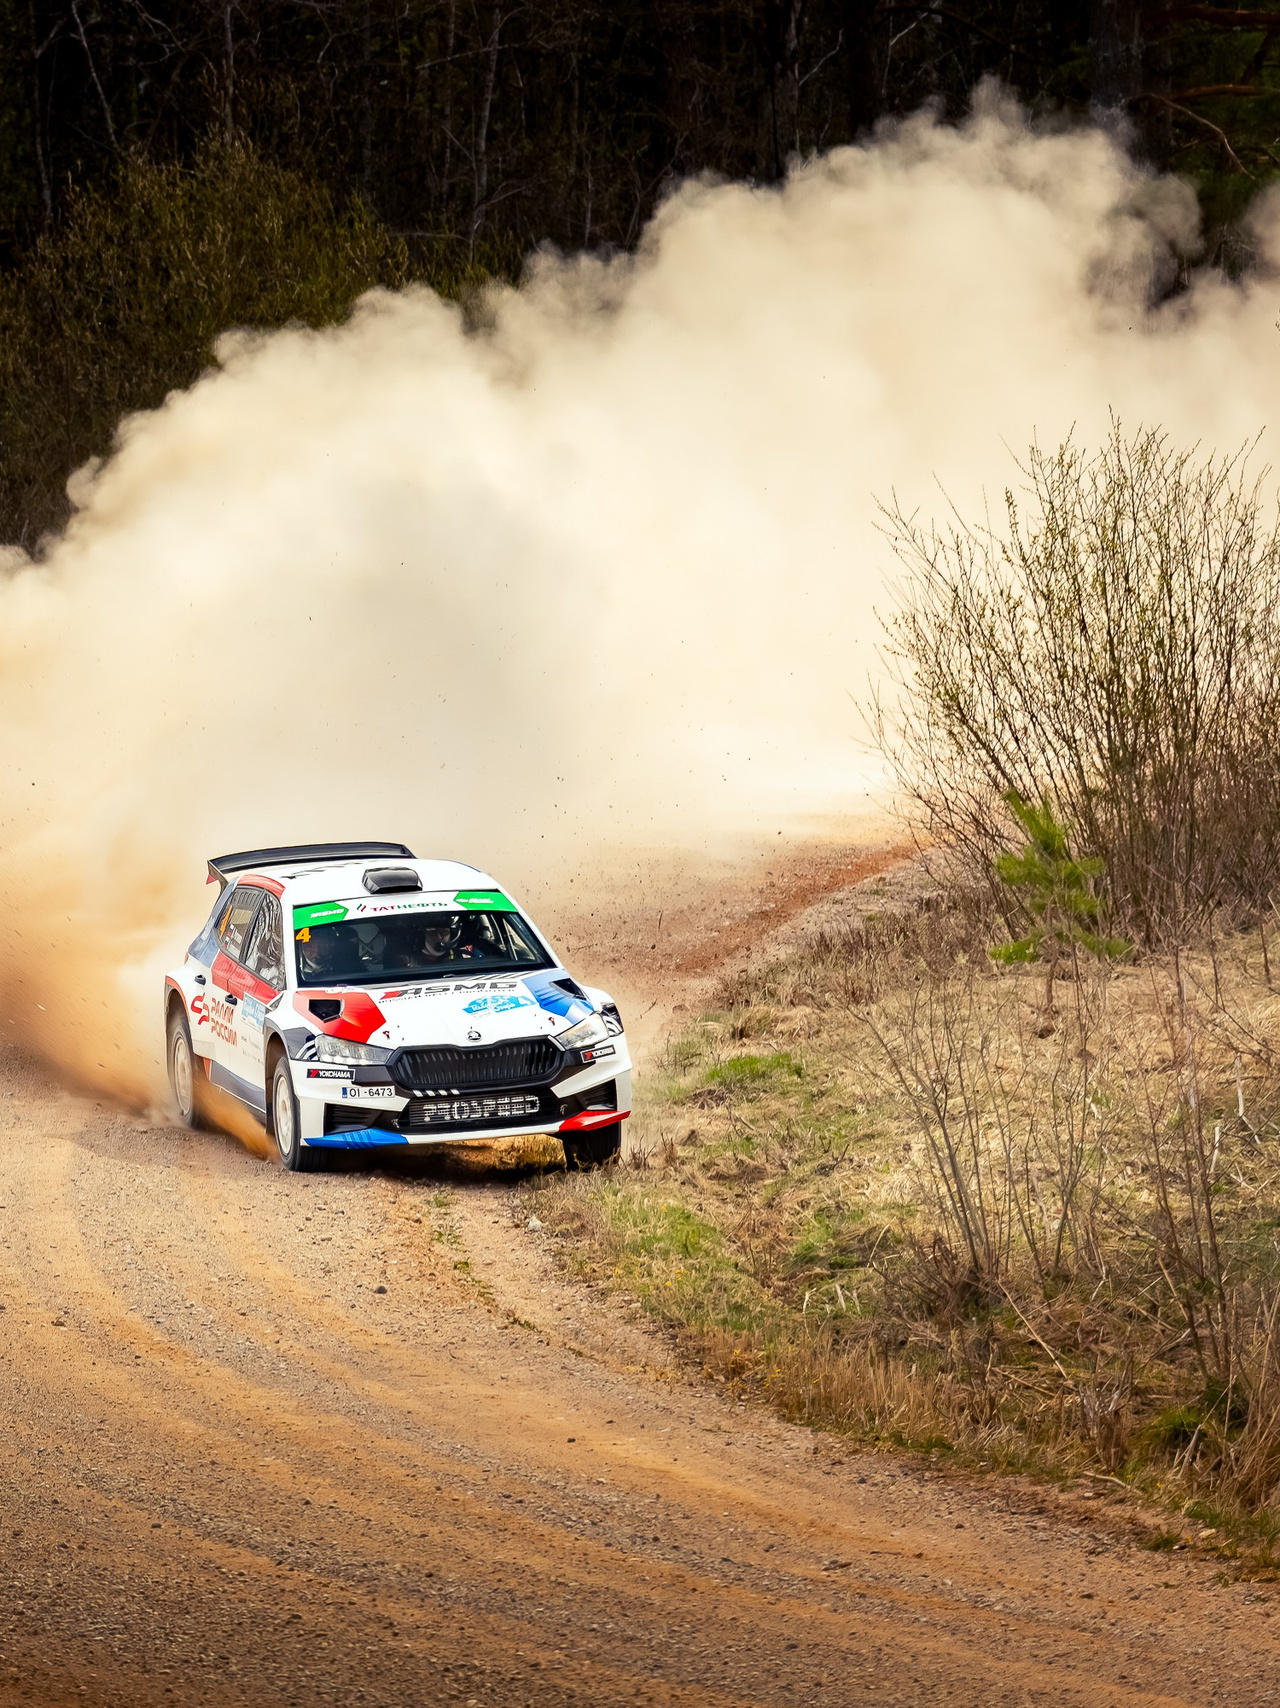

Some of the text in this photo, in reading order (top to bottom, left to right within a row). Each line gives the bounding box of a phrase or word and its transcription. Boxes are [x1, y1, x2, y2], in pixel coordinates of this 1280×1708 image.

[370, 902, 448, 912] ТАТНЕФТЬ
[295, 926, 312, 943] 4
[211, 1017, 238, 1047] РОССИИ
[318, 1070, 351, 1079] YOKOHAMA
[422, 1094, 540, 1122] PROSPEED
